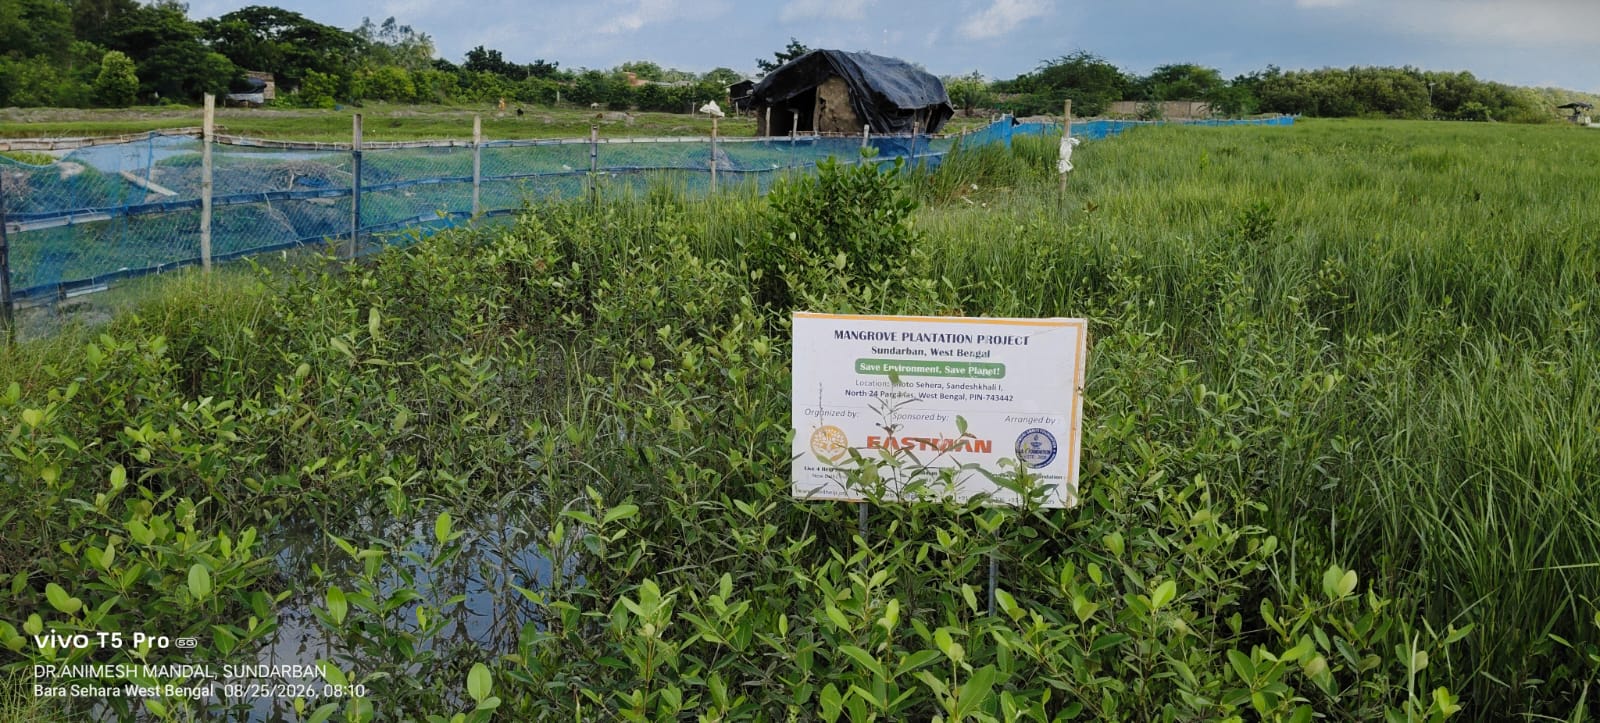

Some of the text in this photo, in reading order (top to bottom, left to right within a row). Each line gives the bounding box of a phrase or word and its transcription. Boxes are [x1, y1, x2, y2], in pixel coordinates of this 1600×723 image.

[834, 330, 1030, 346] MANGROVE PLANTATION PROJECT
[871, 346, 991, 359] Sundarban, West Bengal
[859, 362, 1000, 376] Save Environment, Save Planet!
[946, 382, 997, 391] Sandeshkhali
[845, 389, 868, 397] North
[918, 391, 938, 399] West
[939, 392, 968, 401] Bengal,
[969, 393, 1014, 402] PIN-743442
[804, 408, 846, 418] Organized
[892, 411, 935, 421] Sponsored
[1004, 415, 1044, 425] Arranged
[866, 435, 992, 454] EASTMAN
